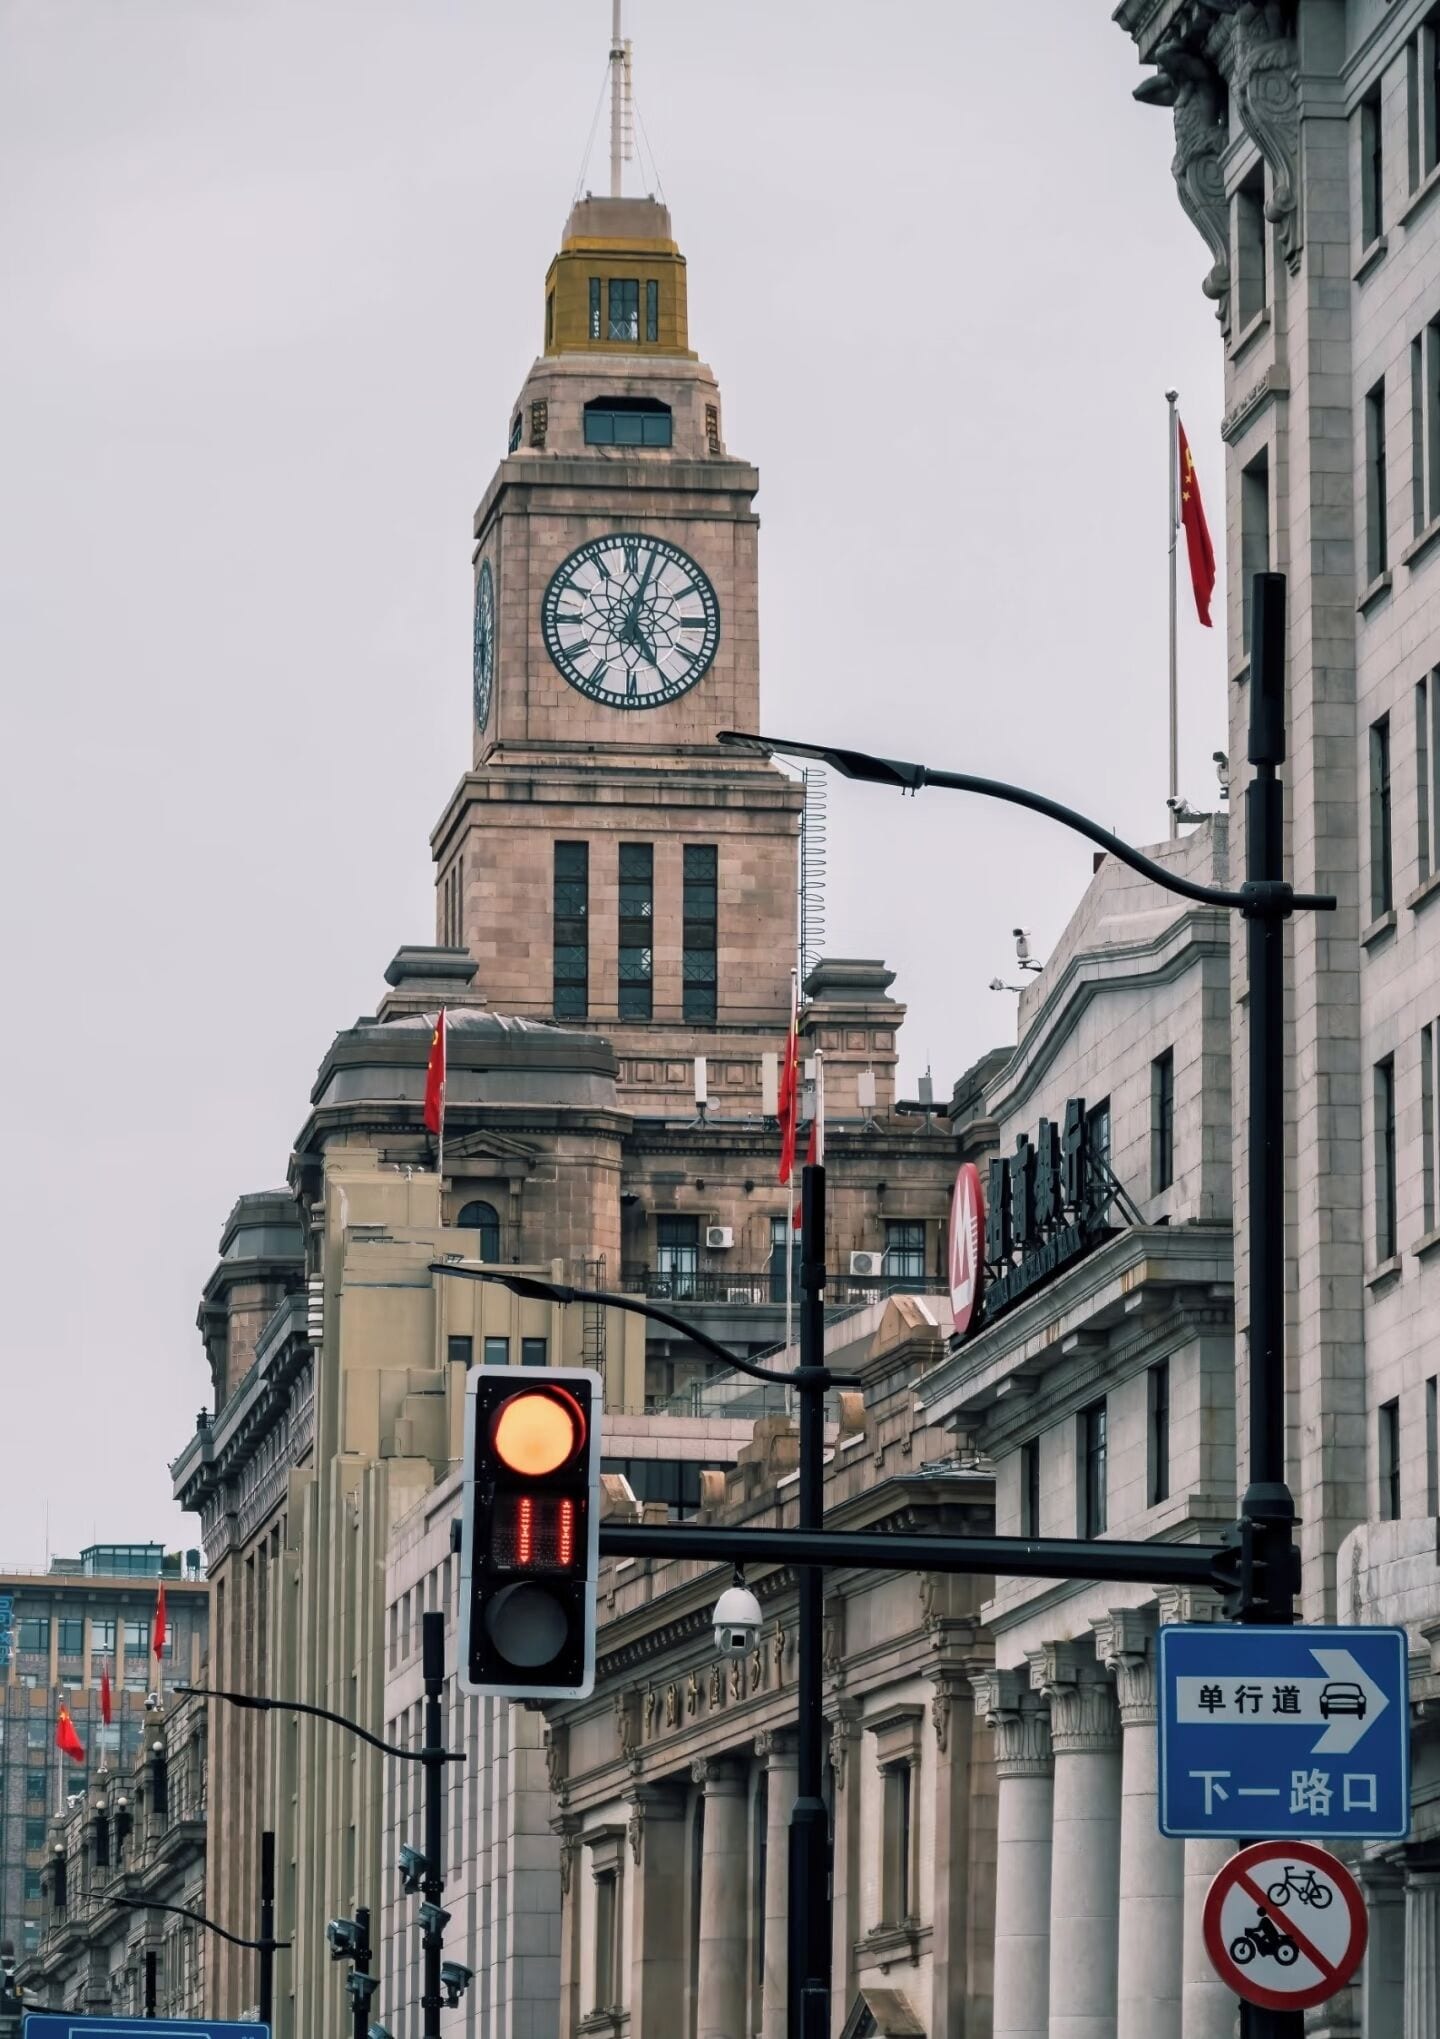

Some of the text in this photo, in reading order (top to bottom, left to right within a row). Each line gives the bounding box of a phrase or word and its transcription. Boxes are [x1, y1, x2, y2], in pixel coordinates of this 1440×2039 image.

[519, 1497, 571, 1565] 11
[1198, 1685, 1302, 1714] 单行道
[1189, 1768, 1378, 1816] 下一路口
